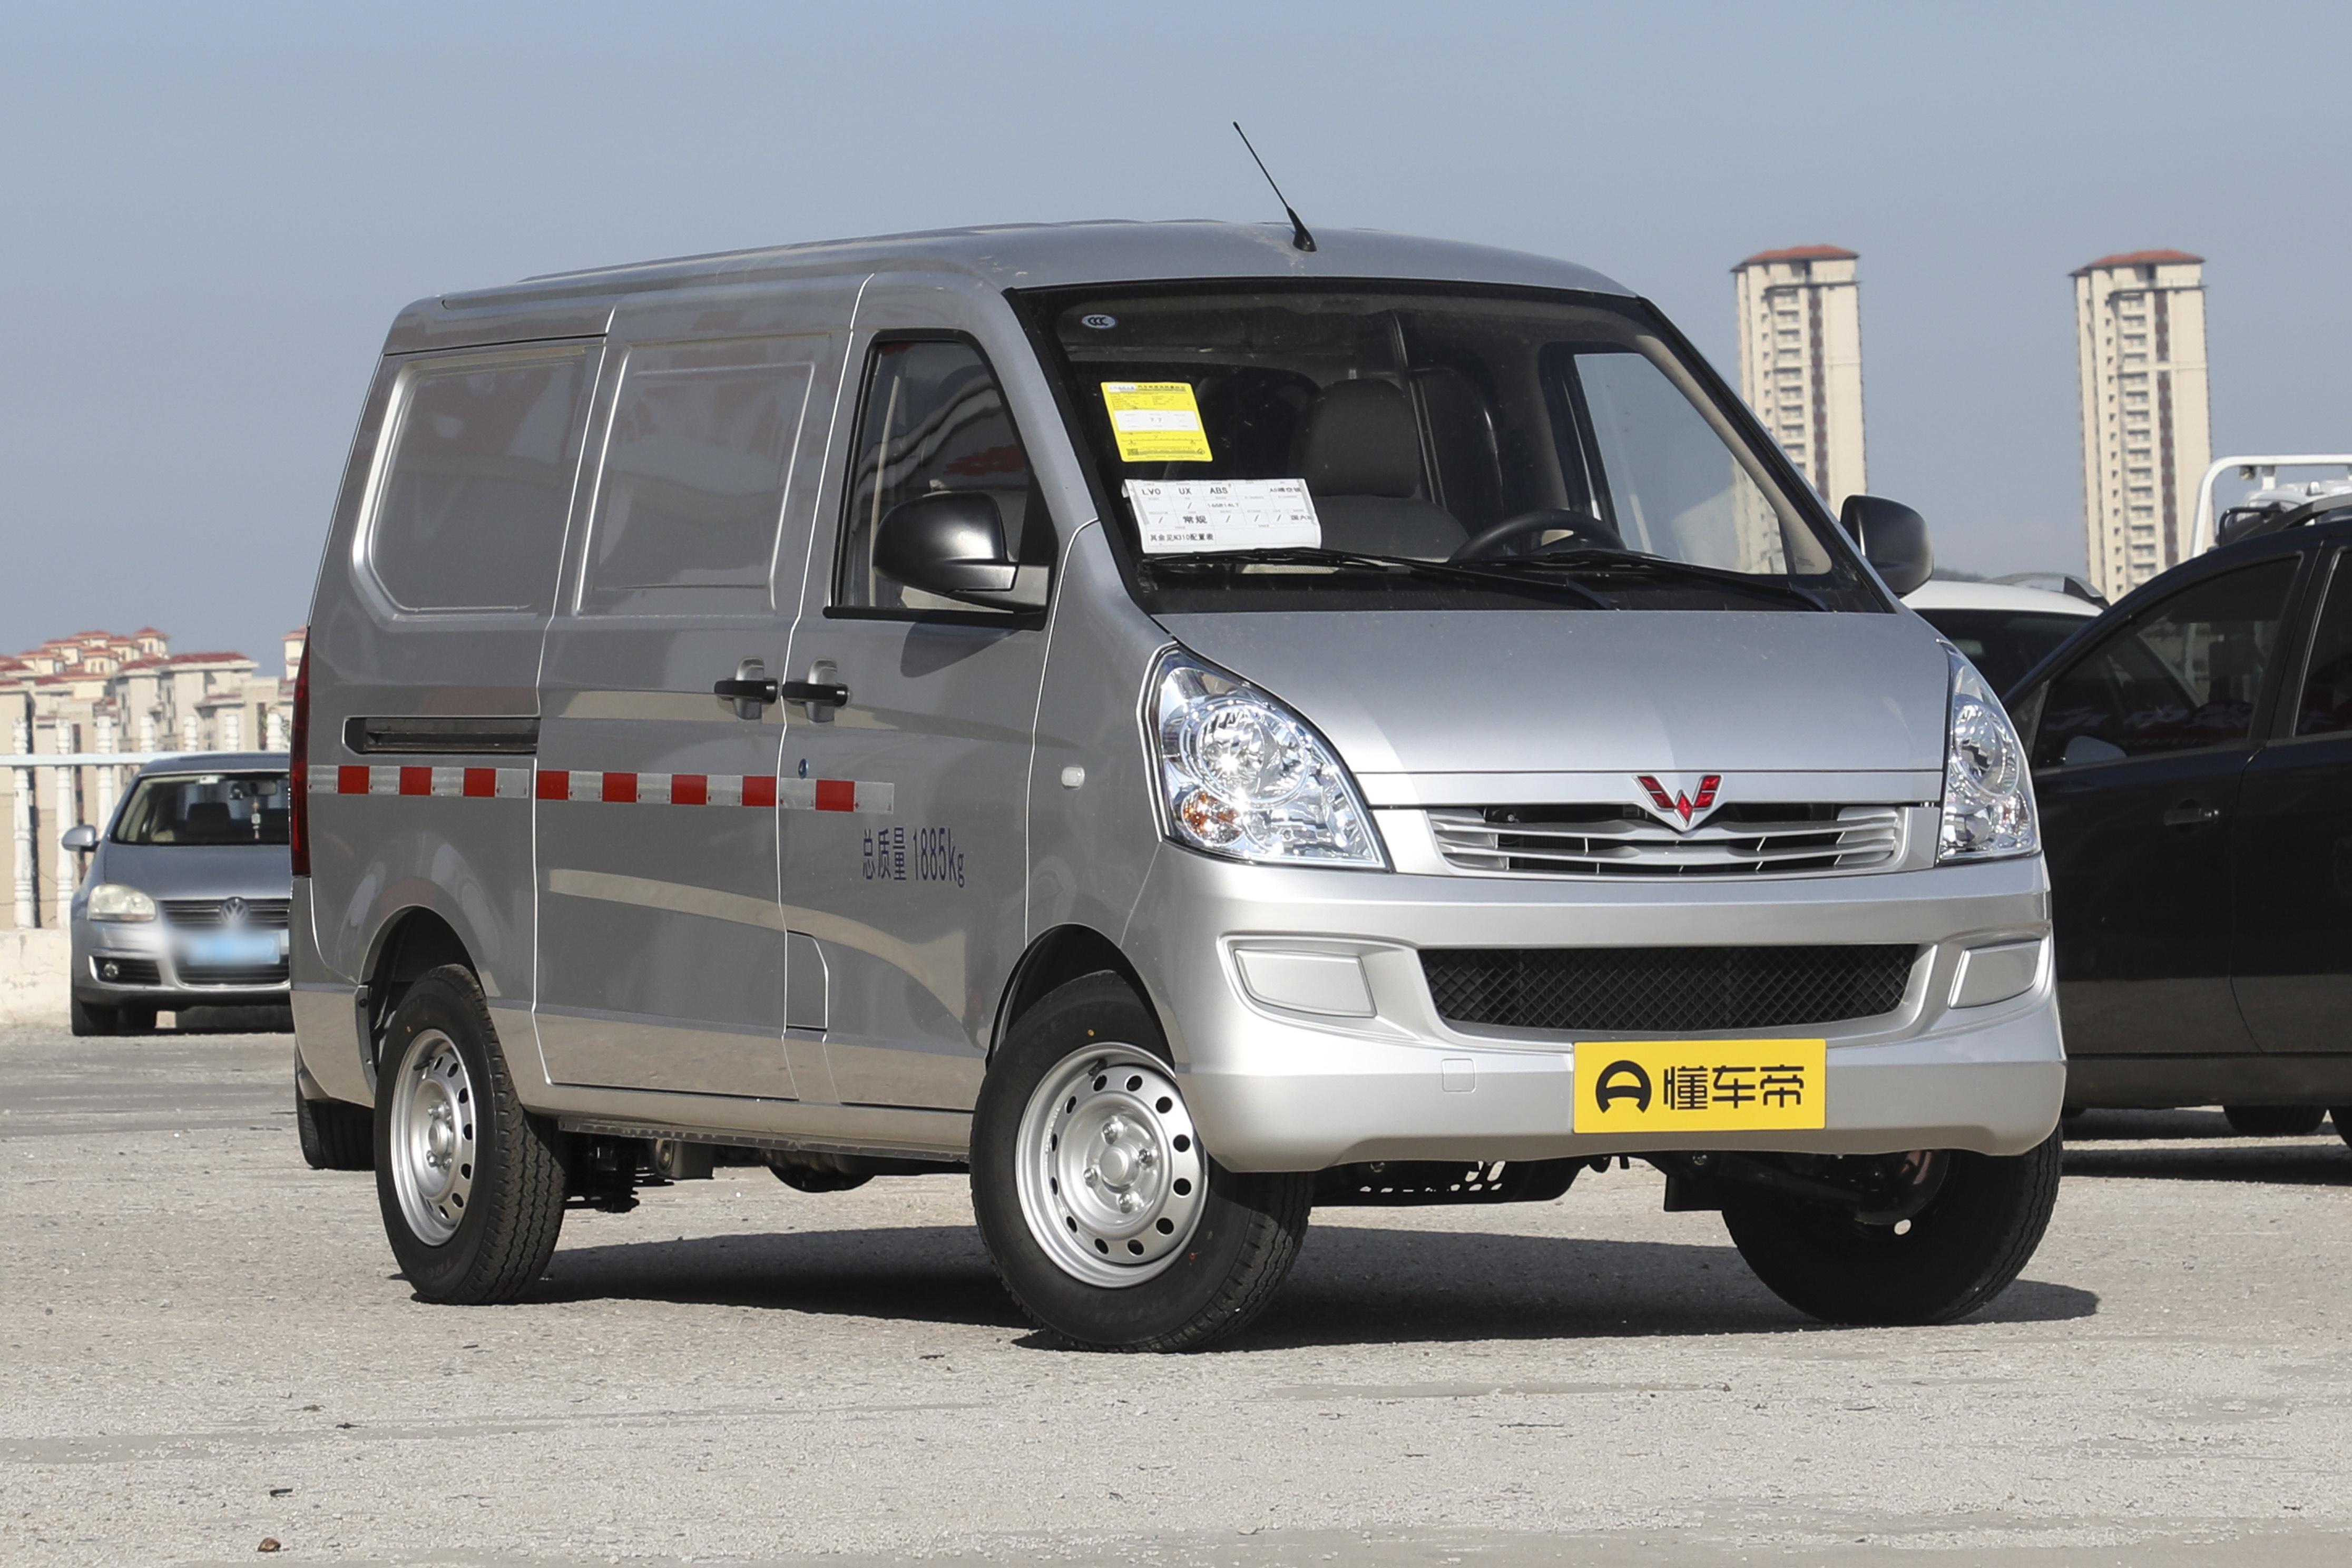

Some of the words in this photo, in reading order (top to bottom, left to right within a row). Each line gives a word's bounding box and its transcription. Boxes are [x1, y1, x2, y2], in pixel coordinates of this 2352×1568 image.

[1088, 317, 1109, 326] CCC
[1183, 515, 1208, 524] 常规
[863, 827, 906, 881] 总质量
[913, 827, 965, 888] 1885kg
[1663, 1064, 1805, 1110] 懂车帝
